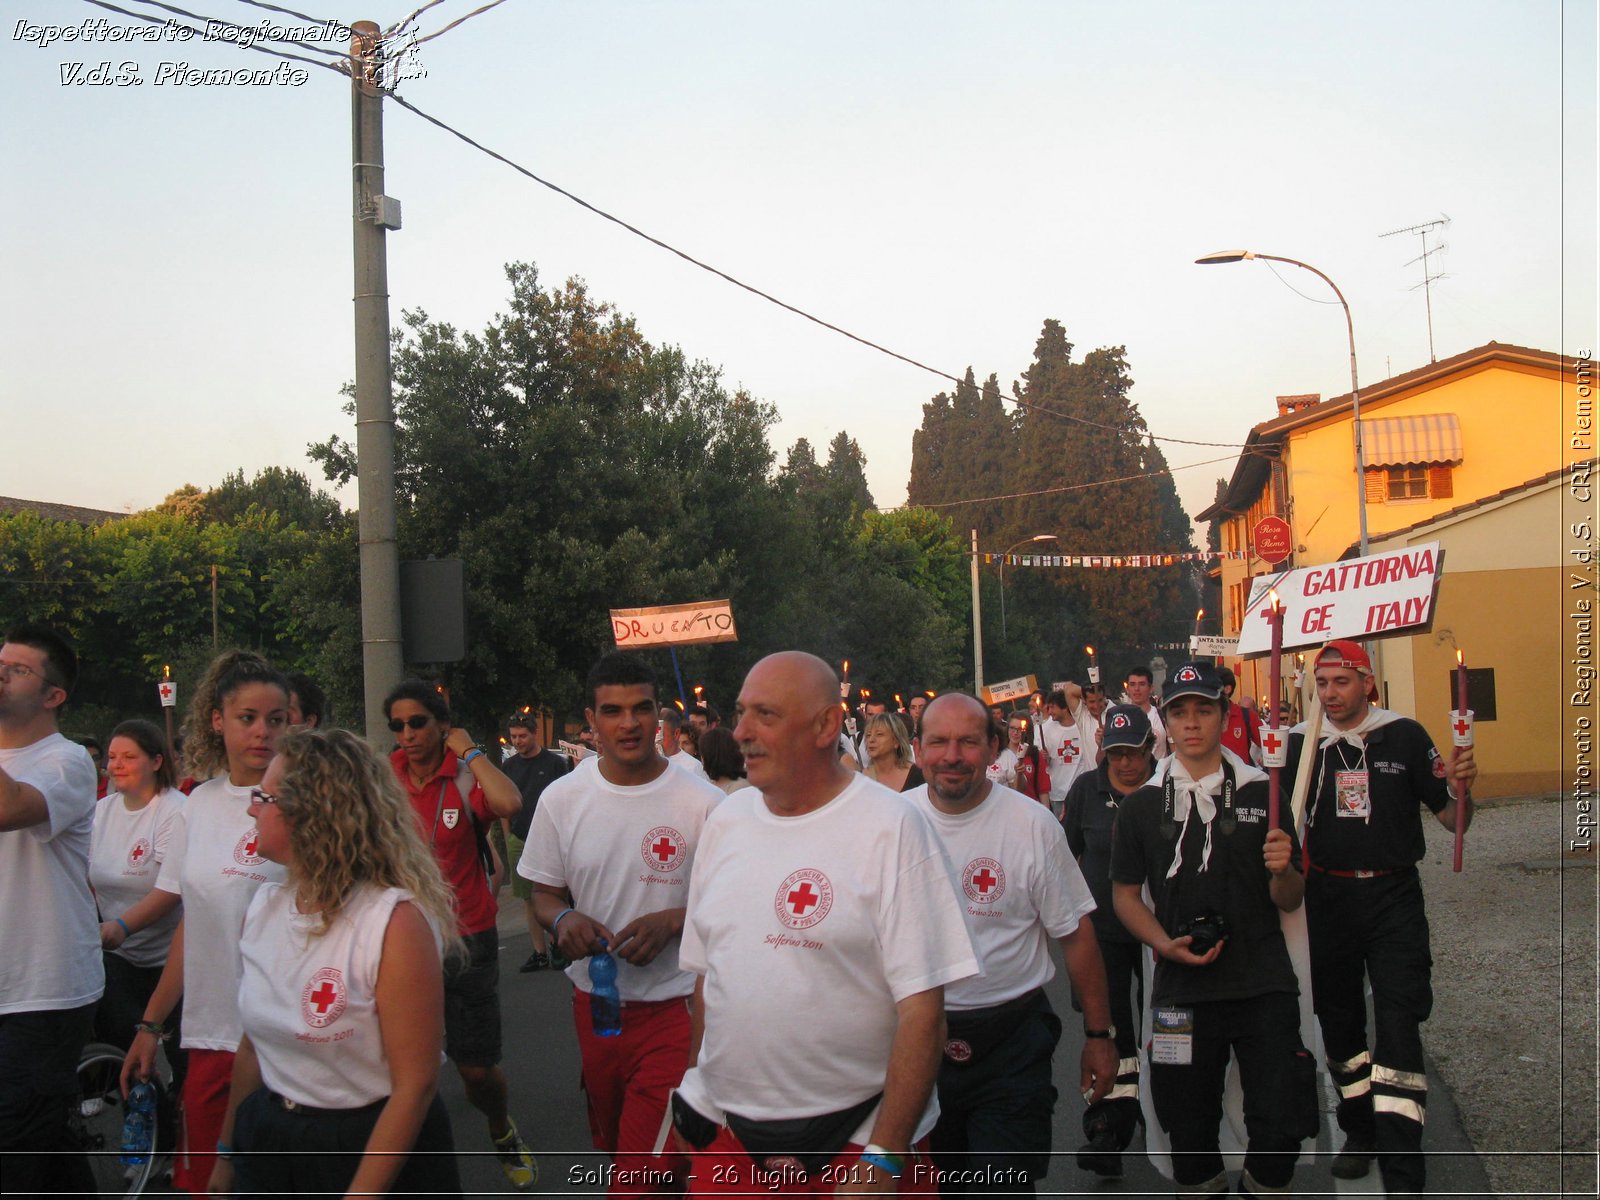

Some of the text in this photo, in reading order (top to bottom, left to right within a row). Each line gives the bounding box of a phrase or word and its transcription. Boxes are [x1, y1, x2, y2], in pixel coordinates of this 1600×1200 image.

[1260, 525, 1281, 534] Rosa
[1260, 539, 1285, 548] Remo
[1303, 549, 1435, 597] GATTORNA
[614, 612, 732, 641] DRUENTO
[1301, 595, 1430, 635] GE ITALY
[1224, 779, 1233, 808] Canon
[1236, 807, 1249, 815] ROCE
[763, 933, 825, 951] Solferino 2011
